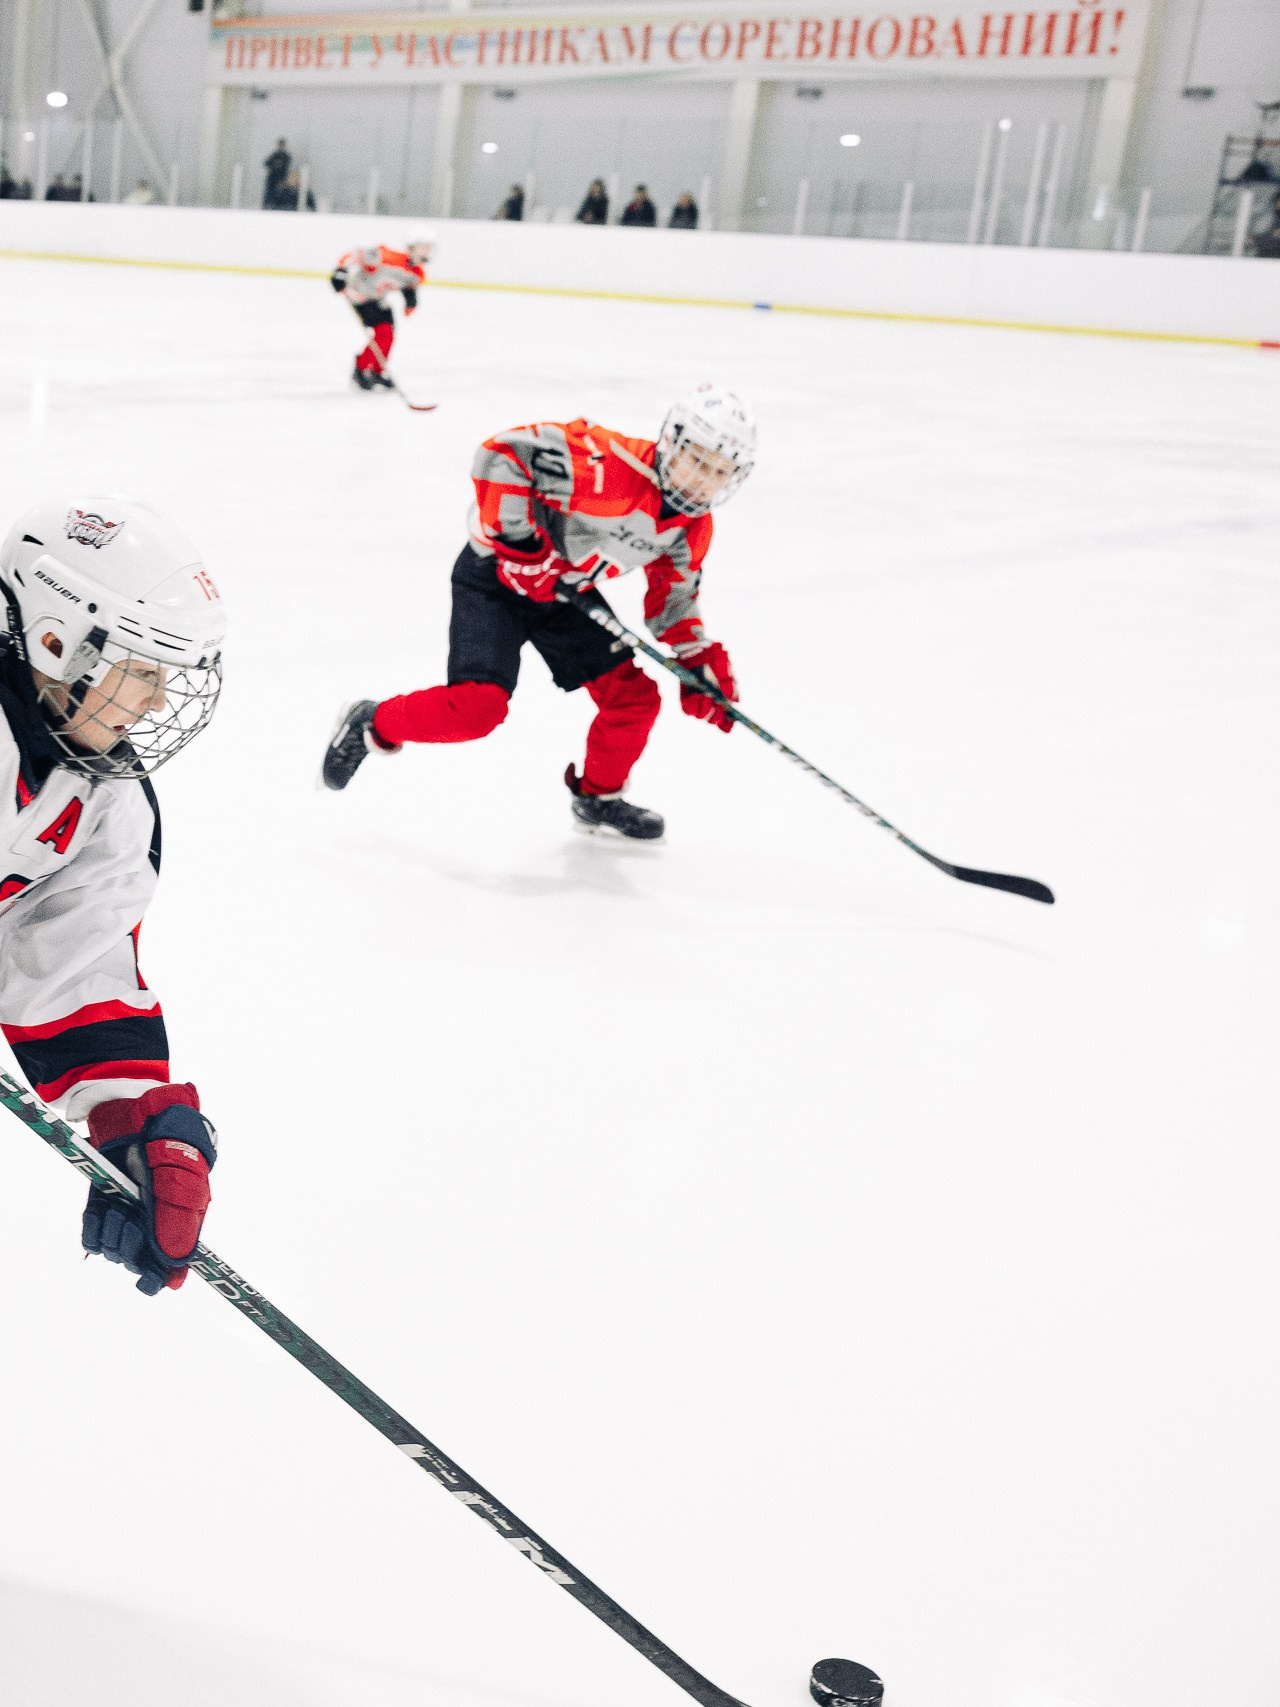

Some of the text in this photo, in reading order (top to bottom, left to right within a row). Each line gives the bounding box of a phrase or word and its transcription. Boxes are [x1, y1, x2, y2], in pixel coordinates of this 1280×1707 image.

[224, 0, 1126, 71] ПРИВЕТ УЧАСТНИКАМ СОРЕВНОВАНИЙ!
[34, 570, 82, 604] BAUER
[35, 795, 84, 855] A
